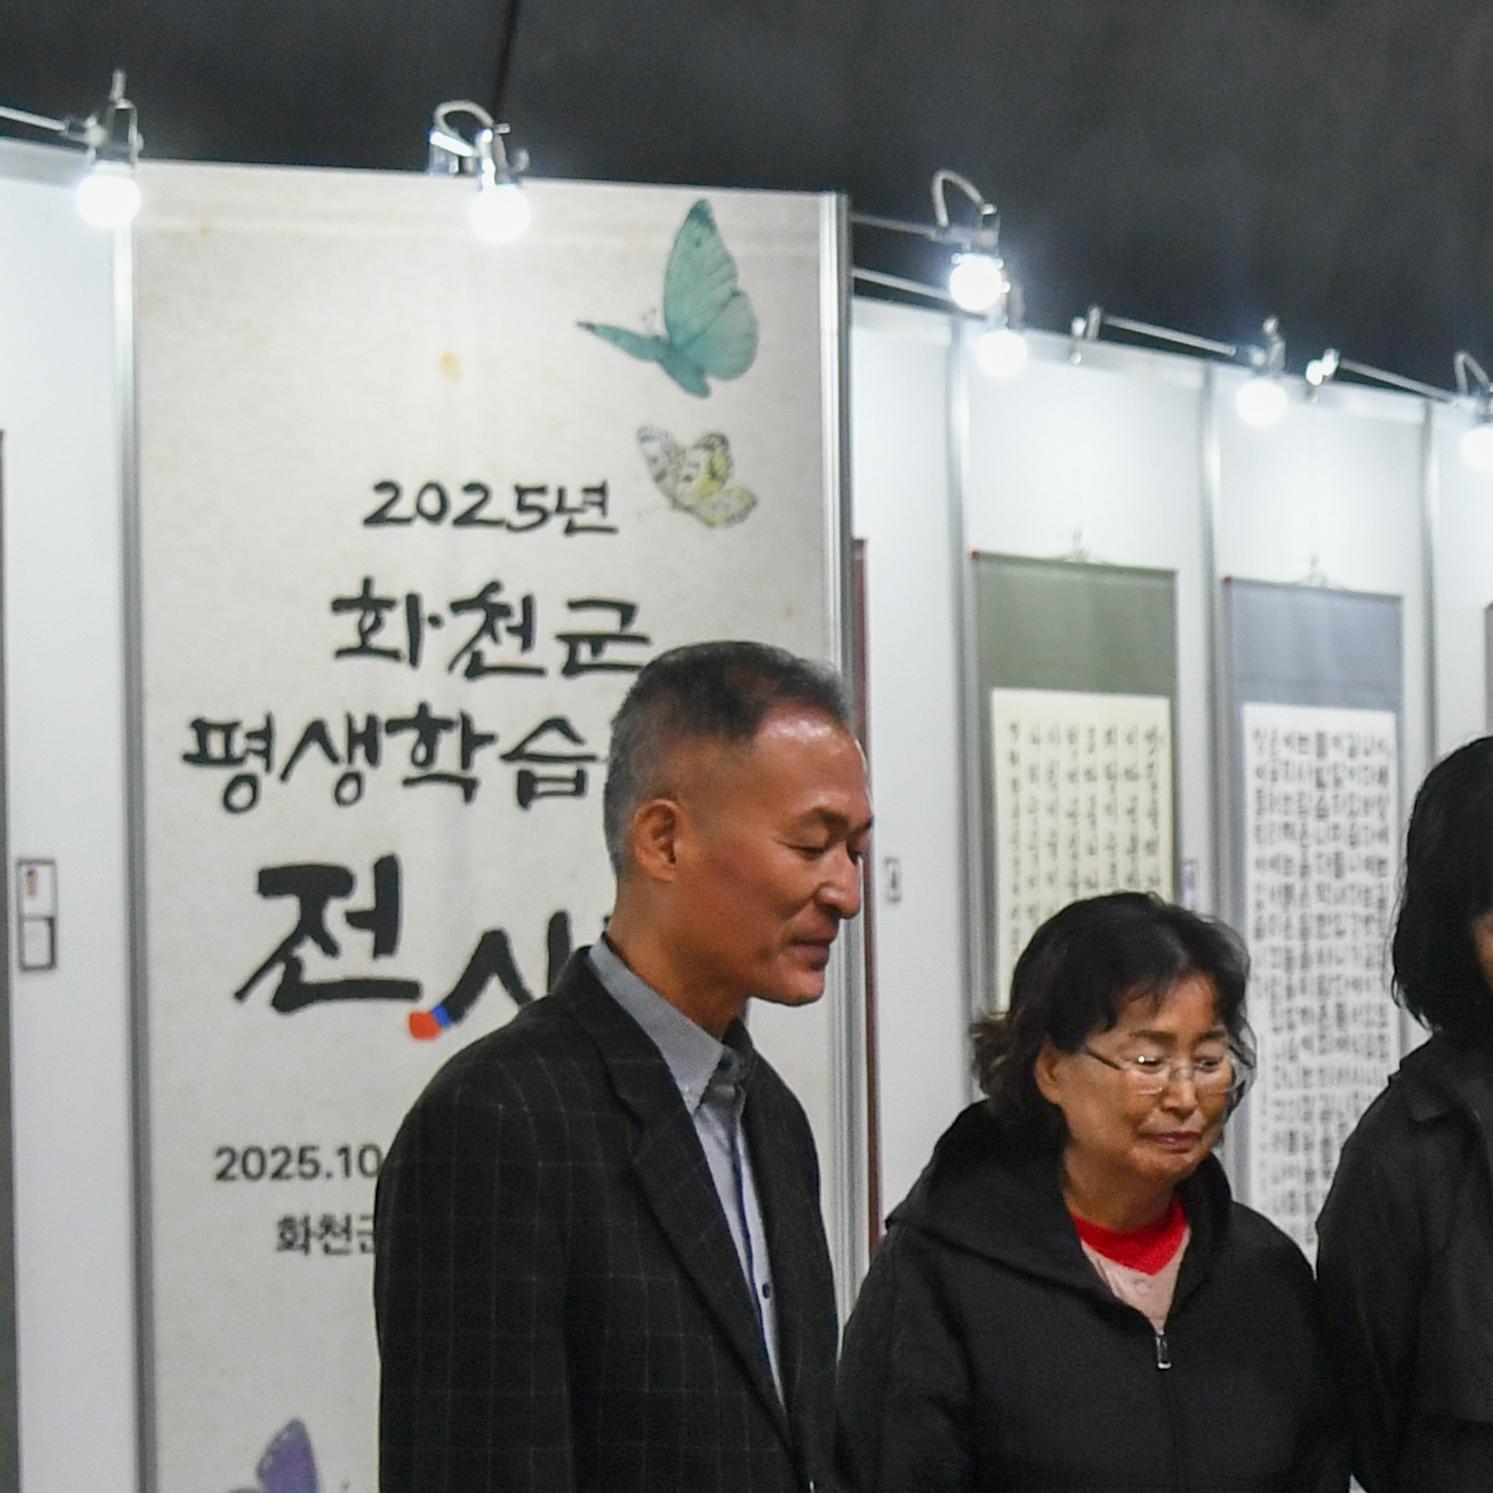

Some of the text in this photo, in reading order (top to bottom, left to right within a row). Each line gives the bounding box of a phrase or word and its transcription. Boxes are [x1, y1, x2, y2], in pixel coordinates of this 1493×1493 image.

[362, 479, 619, 535] 2025년
[330, 576, 652, 679] 화천군
[181, 701, 608, 814] 평생학습
[233, 852, 612, 1041] 전시
